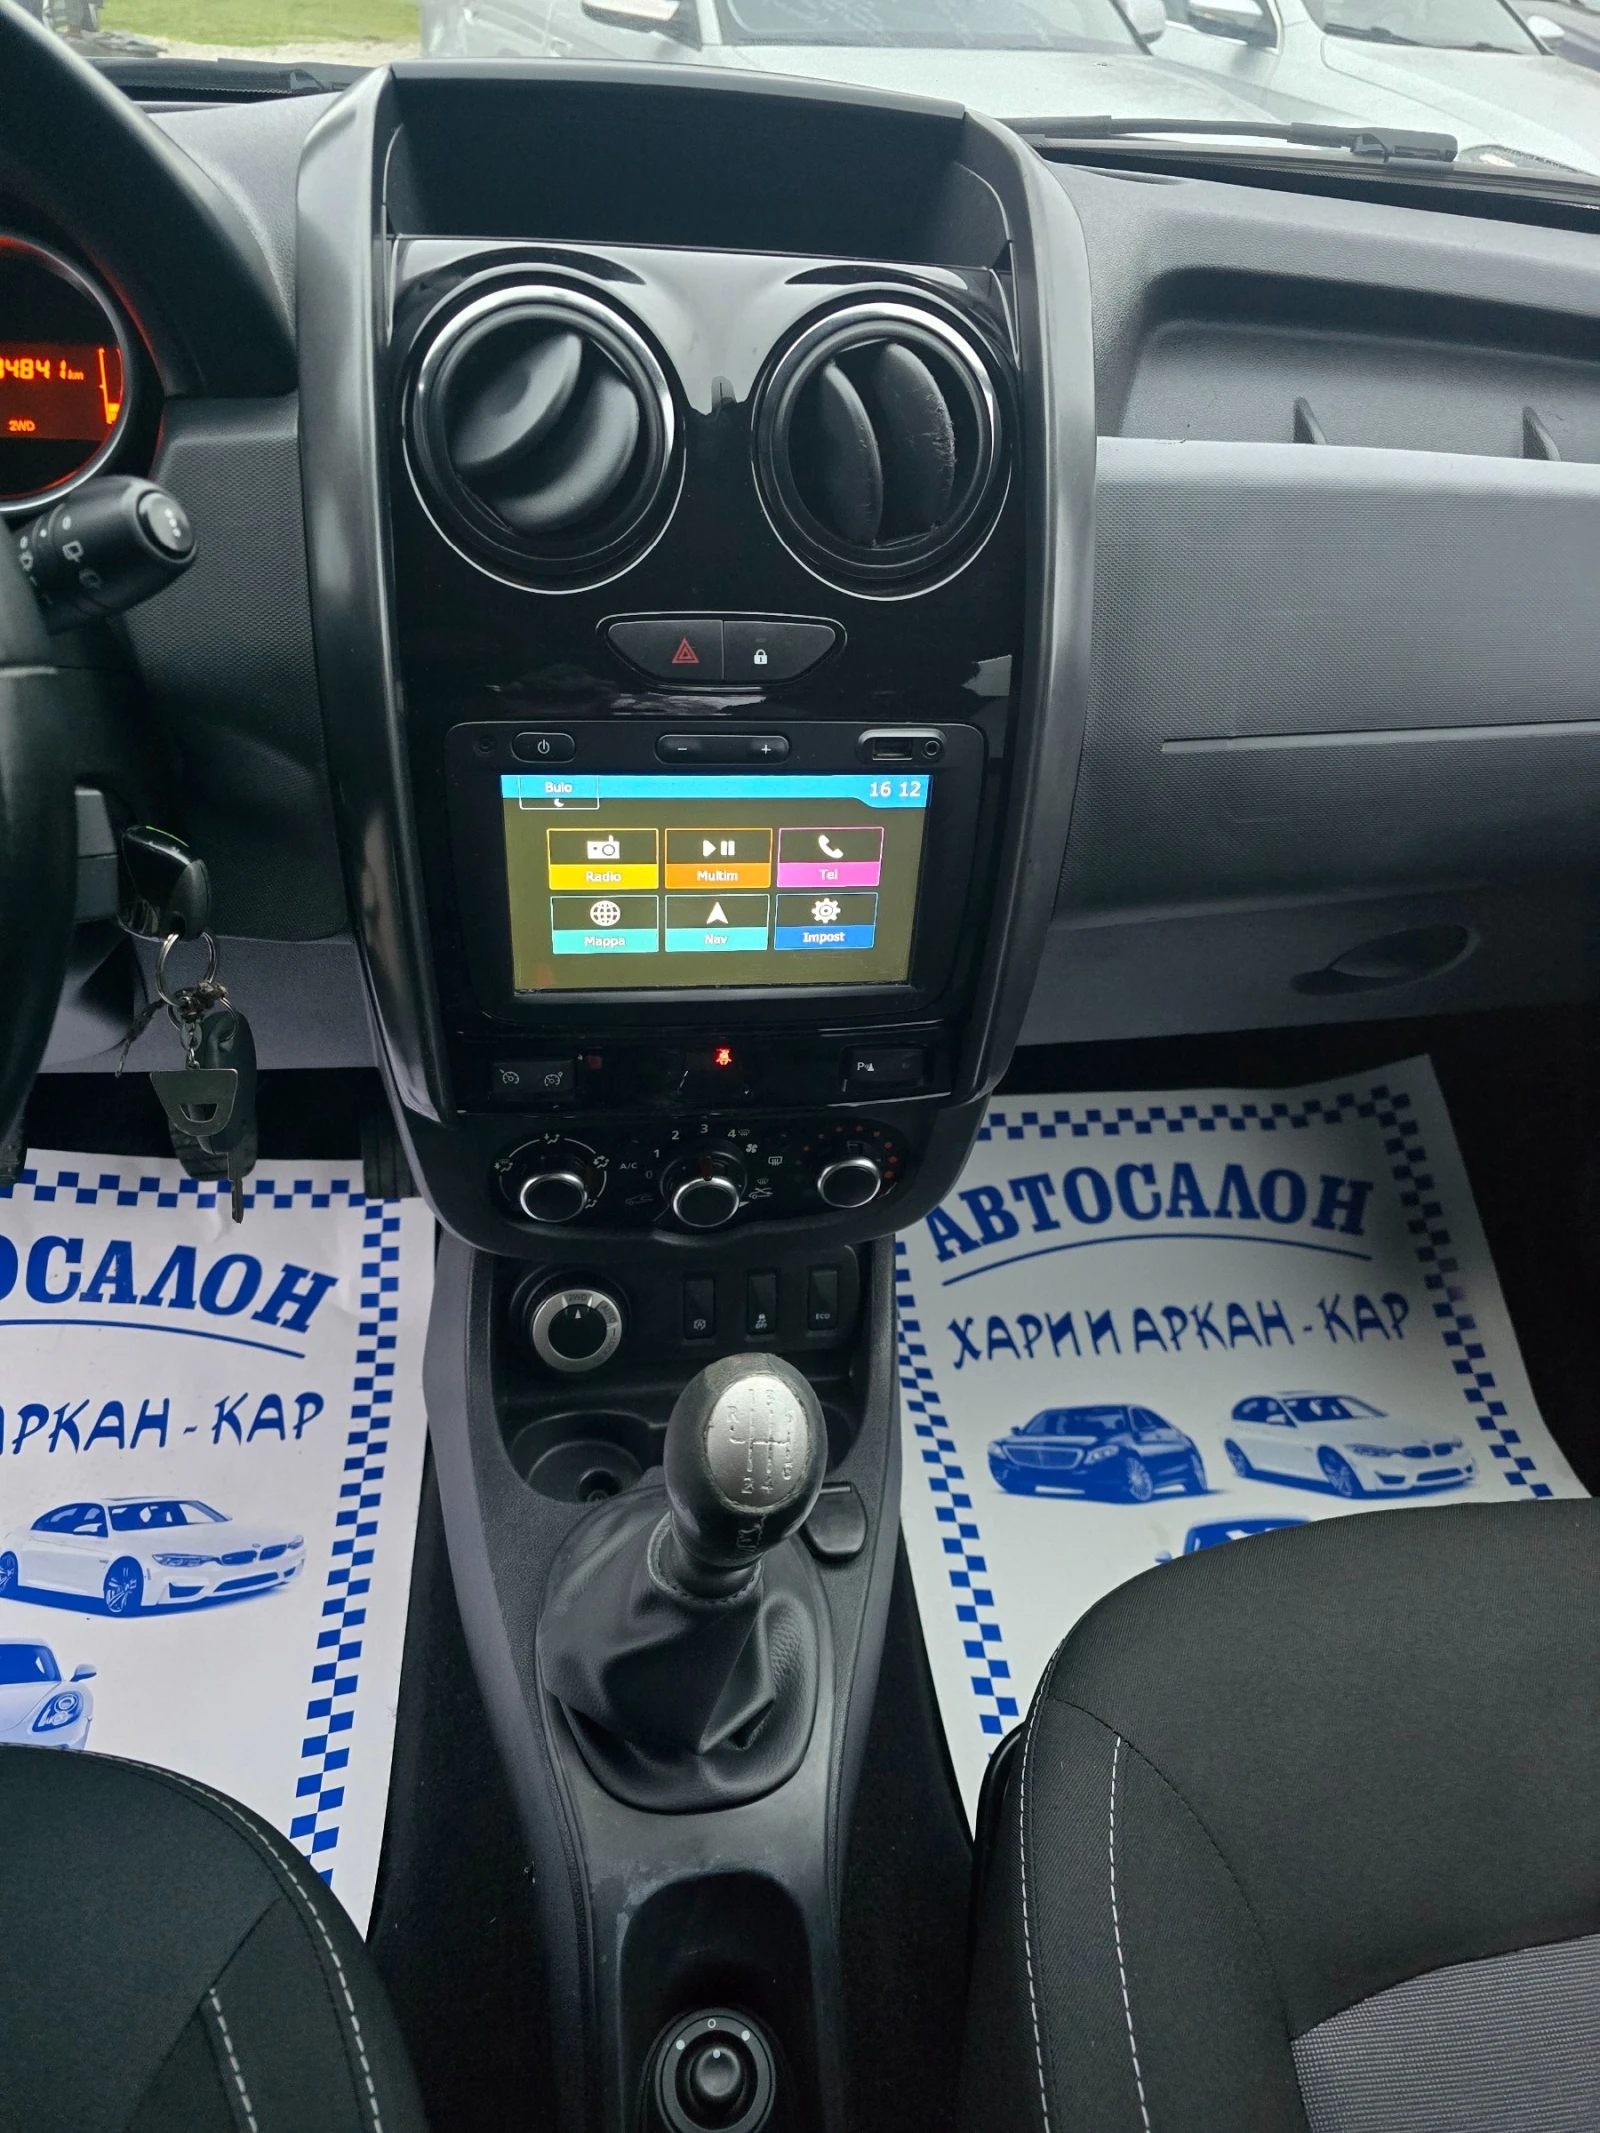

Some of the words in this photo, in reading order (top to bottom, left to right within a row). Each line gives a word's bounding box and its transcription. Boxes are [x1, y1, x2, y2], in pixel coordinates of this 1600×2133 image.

[8, 419, 36, 432] 2WD
[585, 870, 622, 883] Radio
[697, 869, 739, 882] Multim
[819, 868, 838, 881] Tel
[584, 935, 626, 948] Mappa
[704, 933, 728, 945] Nav
[803, 931, 845, 945] Impost
[671, 1130, 680, 1140] 2
[701, 1124, 709, 1134] 3
[727, 1129, 736, 1139] 4
[653, 1149, 660, 1159] 1
[619, 1162, 638, 1170] A/C
[924, 1161, 1374, 1263] АВТОСАЛОН
[815, 1312, 831, 1320] ECO
[0, 1397, 171, 1456] РКАН
